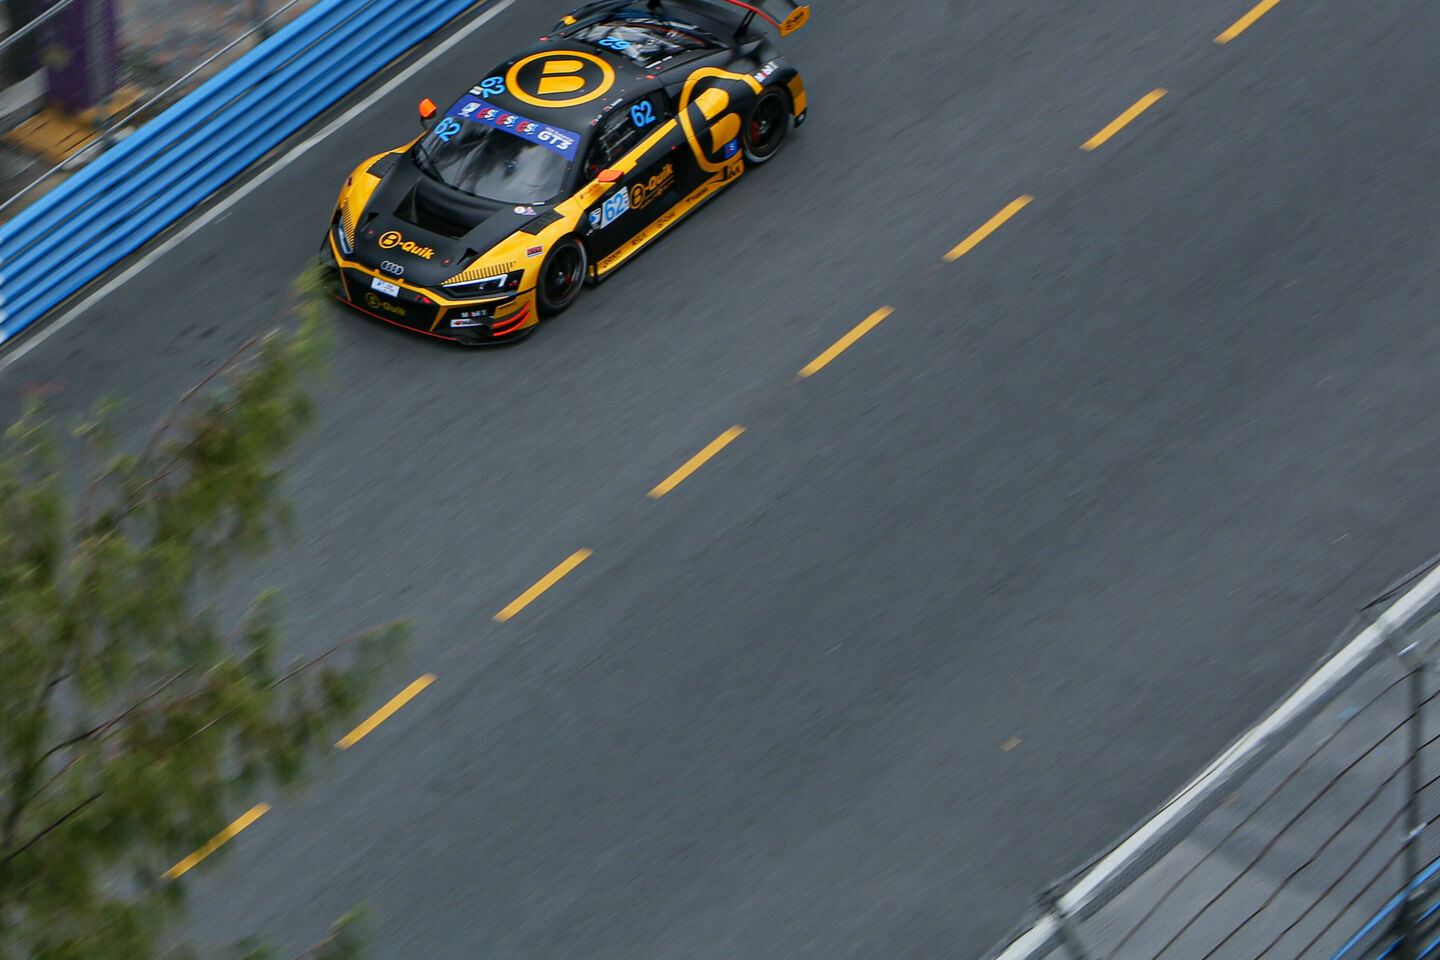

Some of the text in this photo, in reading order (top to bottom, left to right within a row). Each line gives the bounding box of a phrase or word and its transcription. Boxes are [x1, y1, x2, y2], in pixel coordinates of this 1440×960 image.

[480, 76, 506, 99] 62
[630, 100, 656, 128] 62
[434, 116, 462, 143] 62
[537, 130, 573, 151] GT3
[604, 192, 625, 222] 62
[378, 230, 436, 260] B-Quik
